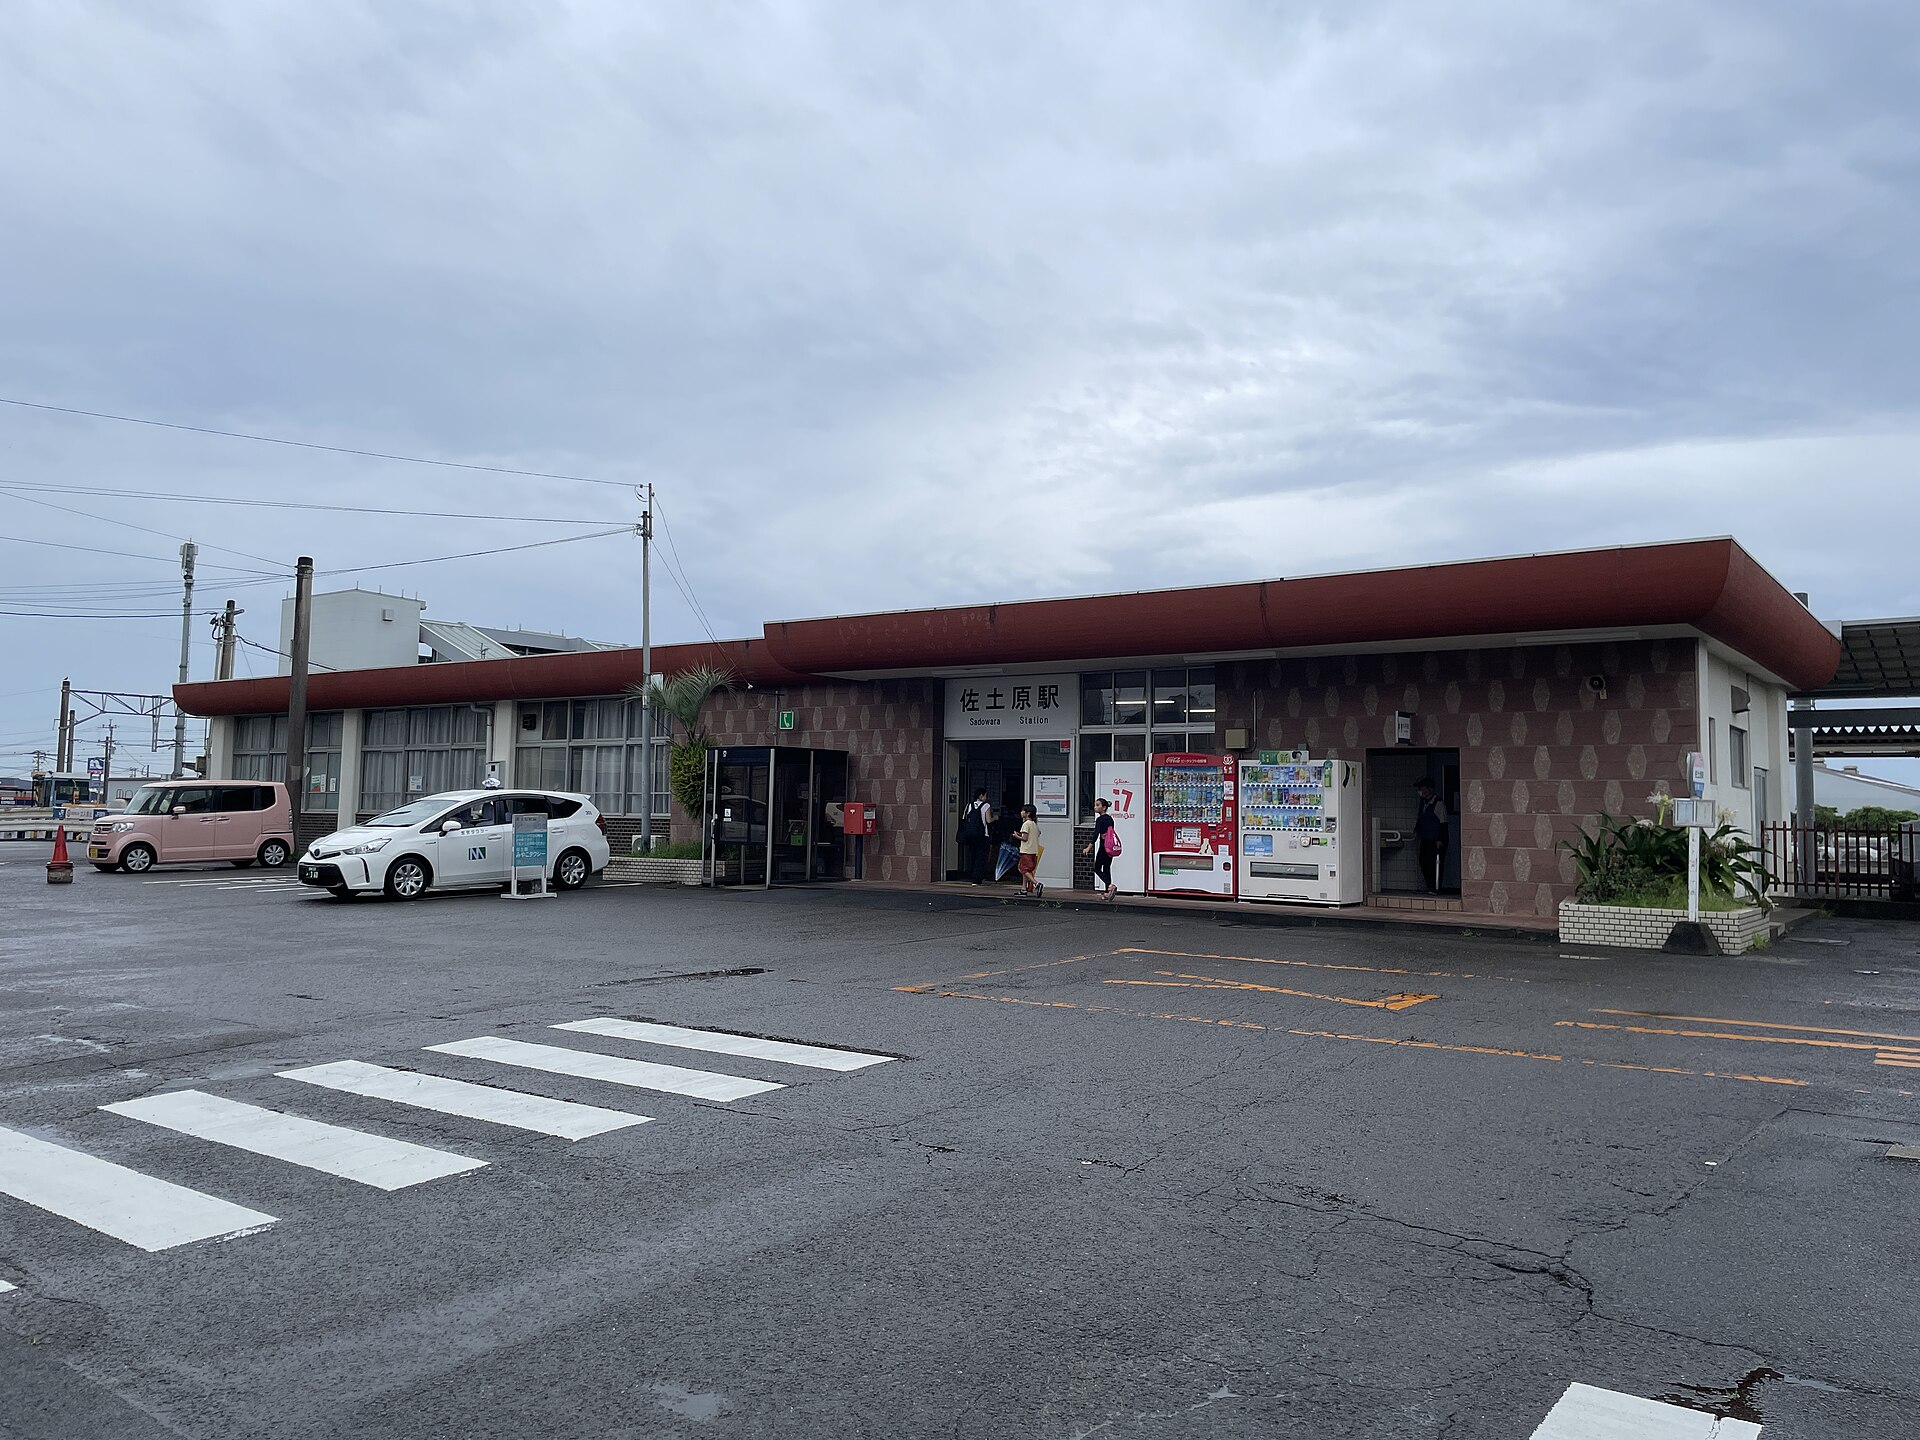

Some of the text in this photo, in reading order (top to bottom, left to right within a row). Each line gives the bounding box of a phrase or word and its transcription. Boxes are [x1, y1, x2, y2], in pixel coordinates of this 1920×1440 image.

[959, 684, 1059, 712] 佐土原駅
[969, 716, 1049, 726] Sadowara Station
[1113, 778, 1130, 786] Glico
